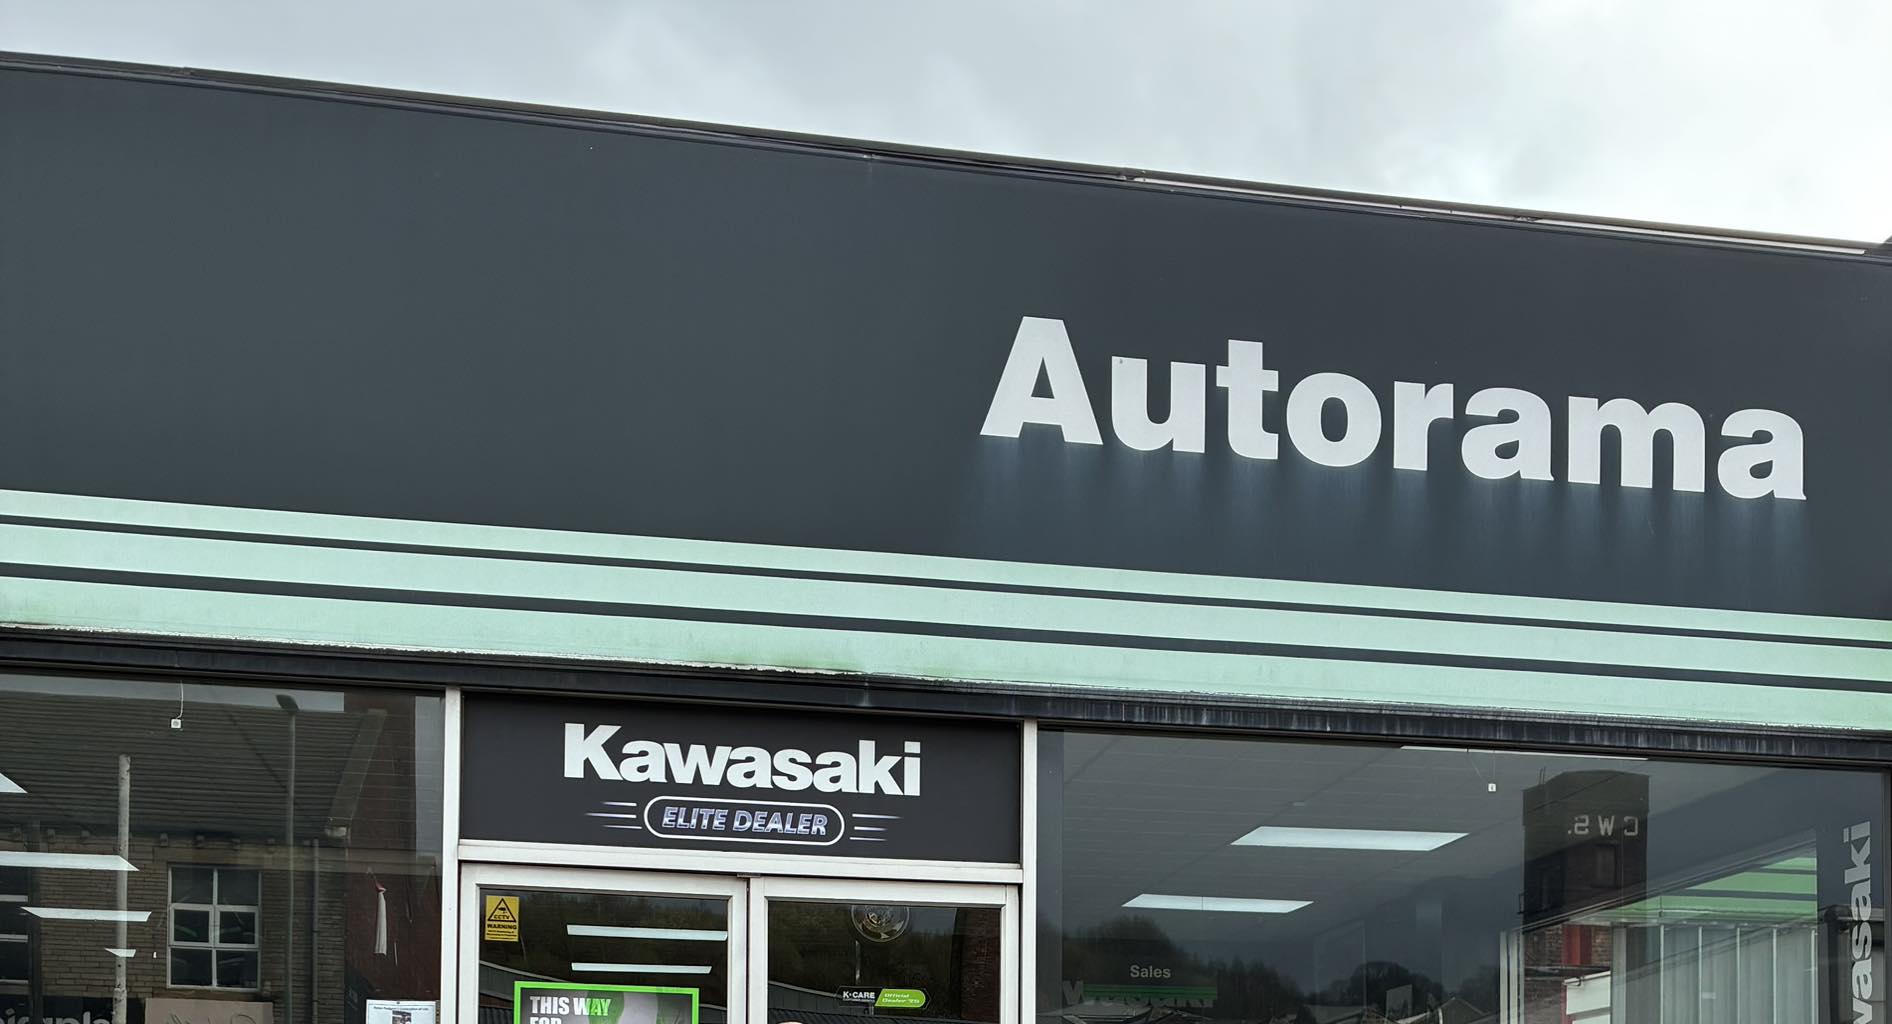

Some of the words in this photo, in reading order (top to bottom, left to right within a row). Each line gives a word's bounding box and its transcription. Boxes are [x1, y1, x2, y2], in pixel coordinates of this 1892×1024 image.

[980, 316, 1806, 501] Autorama
[564, 723, 921, 796] Kawasaki
[662, 806, 729, 831] ELITE
[732, 810, 828, 836] DEALER
[1130, 965, 1171, 978] Sales
[530, 996, 570, 1015] THIS
[573, 998, 611, 1016] WAY
